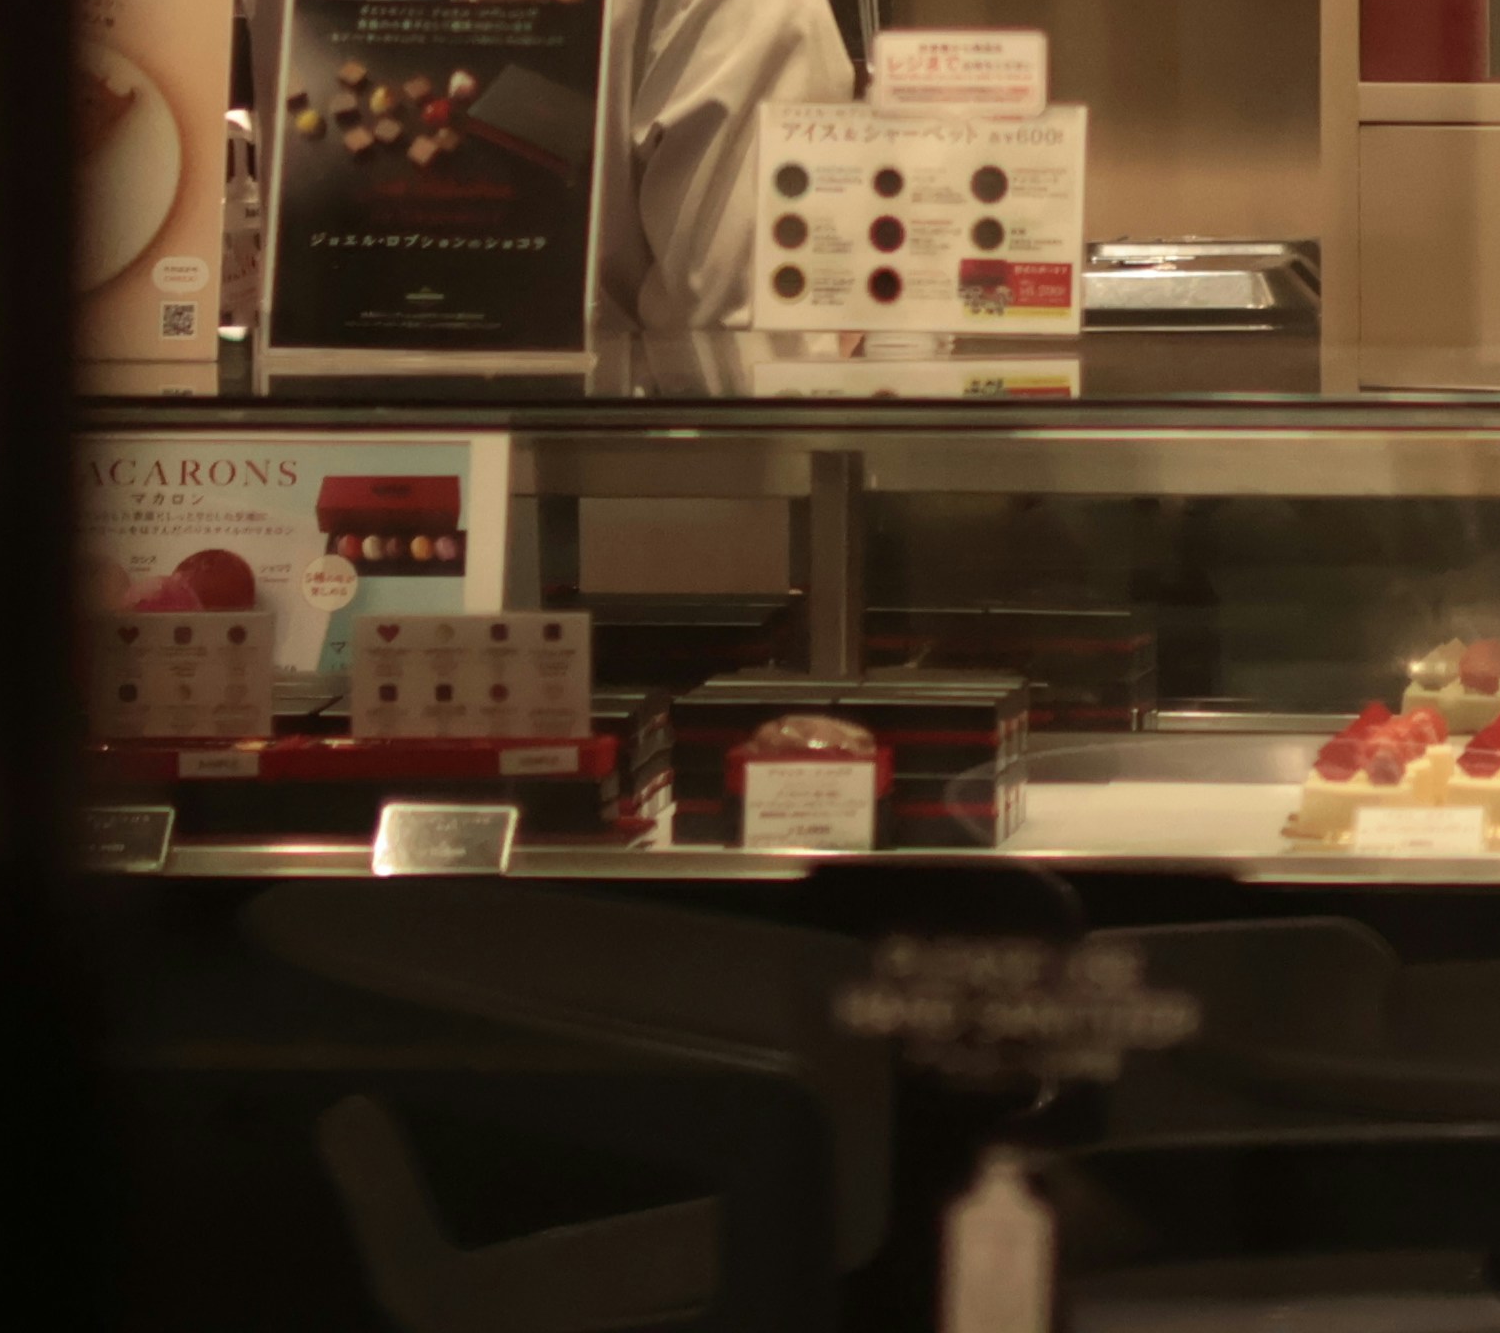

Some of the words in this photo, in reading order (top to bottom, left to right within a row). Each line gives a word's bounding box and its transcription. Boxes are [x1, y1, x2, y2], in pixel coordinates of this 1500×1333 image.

[86, 458, 299, 487] ACARONS
[131, 492, 205, 506] マカロン
